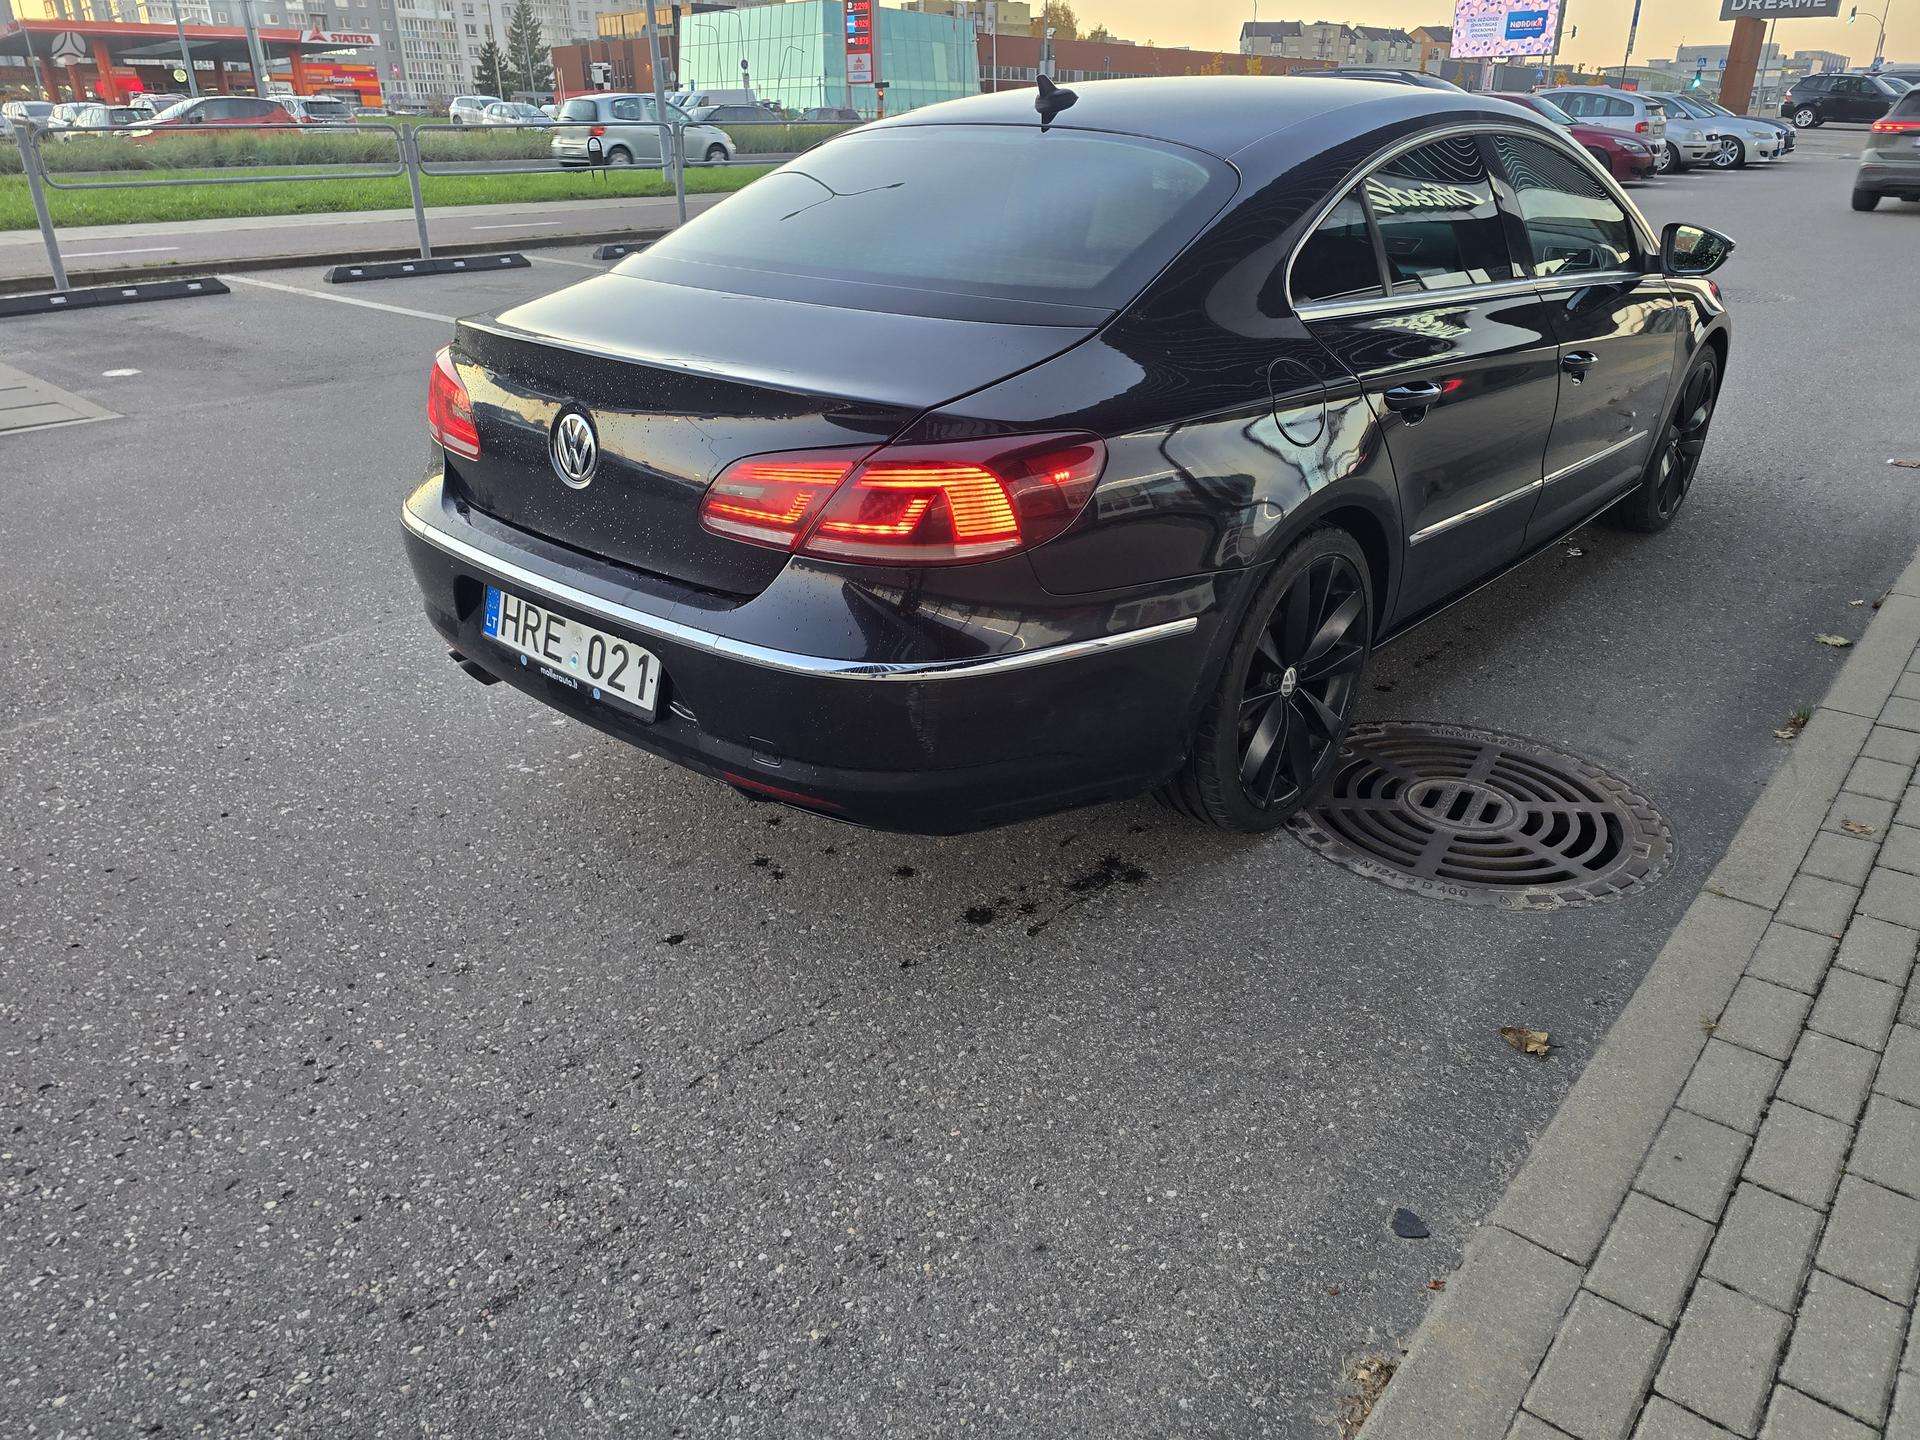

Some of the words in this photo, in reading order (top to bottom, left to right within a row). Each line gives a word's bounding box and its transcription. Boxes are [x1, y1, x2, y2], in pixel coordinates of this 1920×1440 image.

[330, 33, 374, 44] STATETA
[485, 616, 498, 629] LT
[501, 595, 566, 664] HRE
[587, 633, 650, 701] 021
